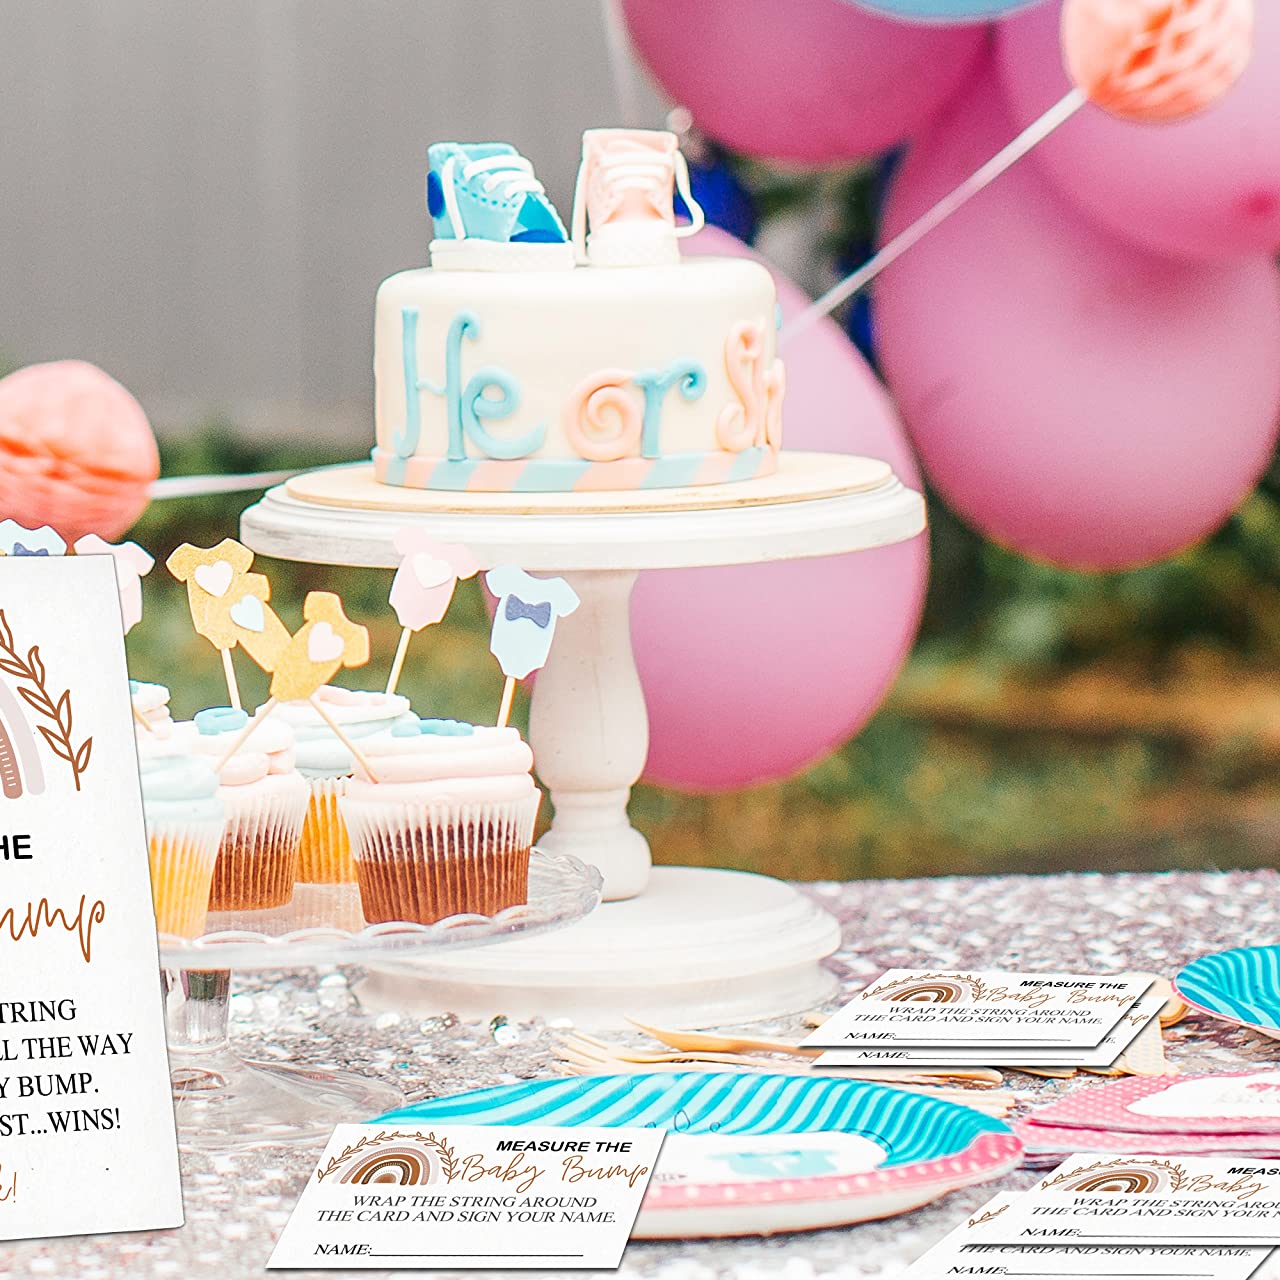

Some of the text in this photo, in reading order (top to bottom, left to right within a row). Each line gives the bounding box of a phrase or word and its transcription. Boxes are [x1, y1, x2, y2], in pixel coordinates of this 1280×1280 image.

[394, 306, 546, 461] He
[565, 358, 708, 462] or
[1020, 980, 1128, 990] MEASURE THE
[985, 986, 1136, 1009] Baby Bump
[970, 1008, 1029, 1016] STRING
[1029, 1009, 1091, 1017] AROUND
[974, 1016, 1015, 1024] SIGN
[1059, 1017, 1103, 1025] NAME.
[843, 1032, 897, 1040] NAME:
[22, 1036, 73, 1060] THE
[77, 1033, 134, 1056] WAY
[17, 1072, 100, 1098] BUMP.
[496, 1141, 633, 1153] MEASURE THE
[461, 1152, 649, 1194] Baby Bump
[1227, 1167, 1280, 1175] MEAS
[1187, 1174, 1270, 1200] Baby
[353, 1195, 597, 1208] WRAP THE STRING AROUND
[1073, 1198, 1129, 1206] WRAP
[1131, 1199, 1169, 1207] THE
[1169, 1200, 1237, 1208] STRING
[316, 1210, 617, 1223] THE CARD AND SIGN YOUR NAME.
[1031, 1207, 1071, 1216] THE
[1072, 1208, 1129, 1216] CARD
[1128, 1208, 1173, 1216] AND
[1173, 1209, 1220, 1217] SIGN
[1222, 1209, 1270, 1218] YOUR
[1019, 1228, 1082, 1236] NAME:
[313, 1244, 373, 1255] NAME:
[957, 1243, 1252, 1257] THE CARD AND SIGN YOUR NAME.
[945, 1266, 1009, 1275] NAME:
